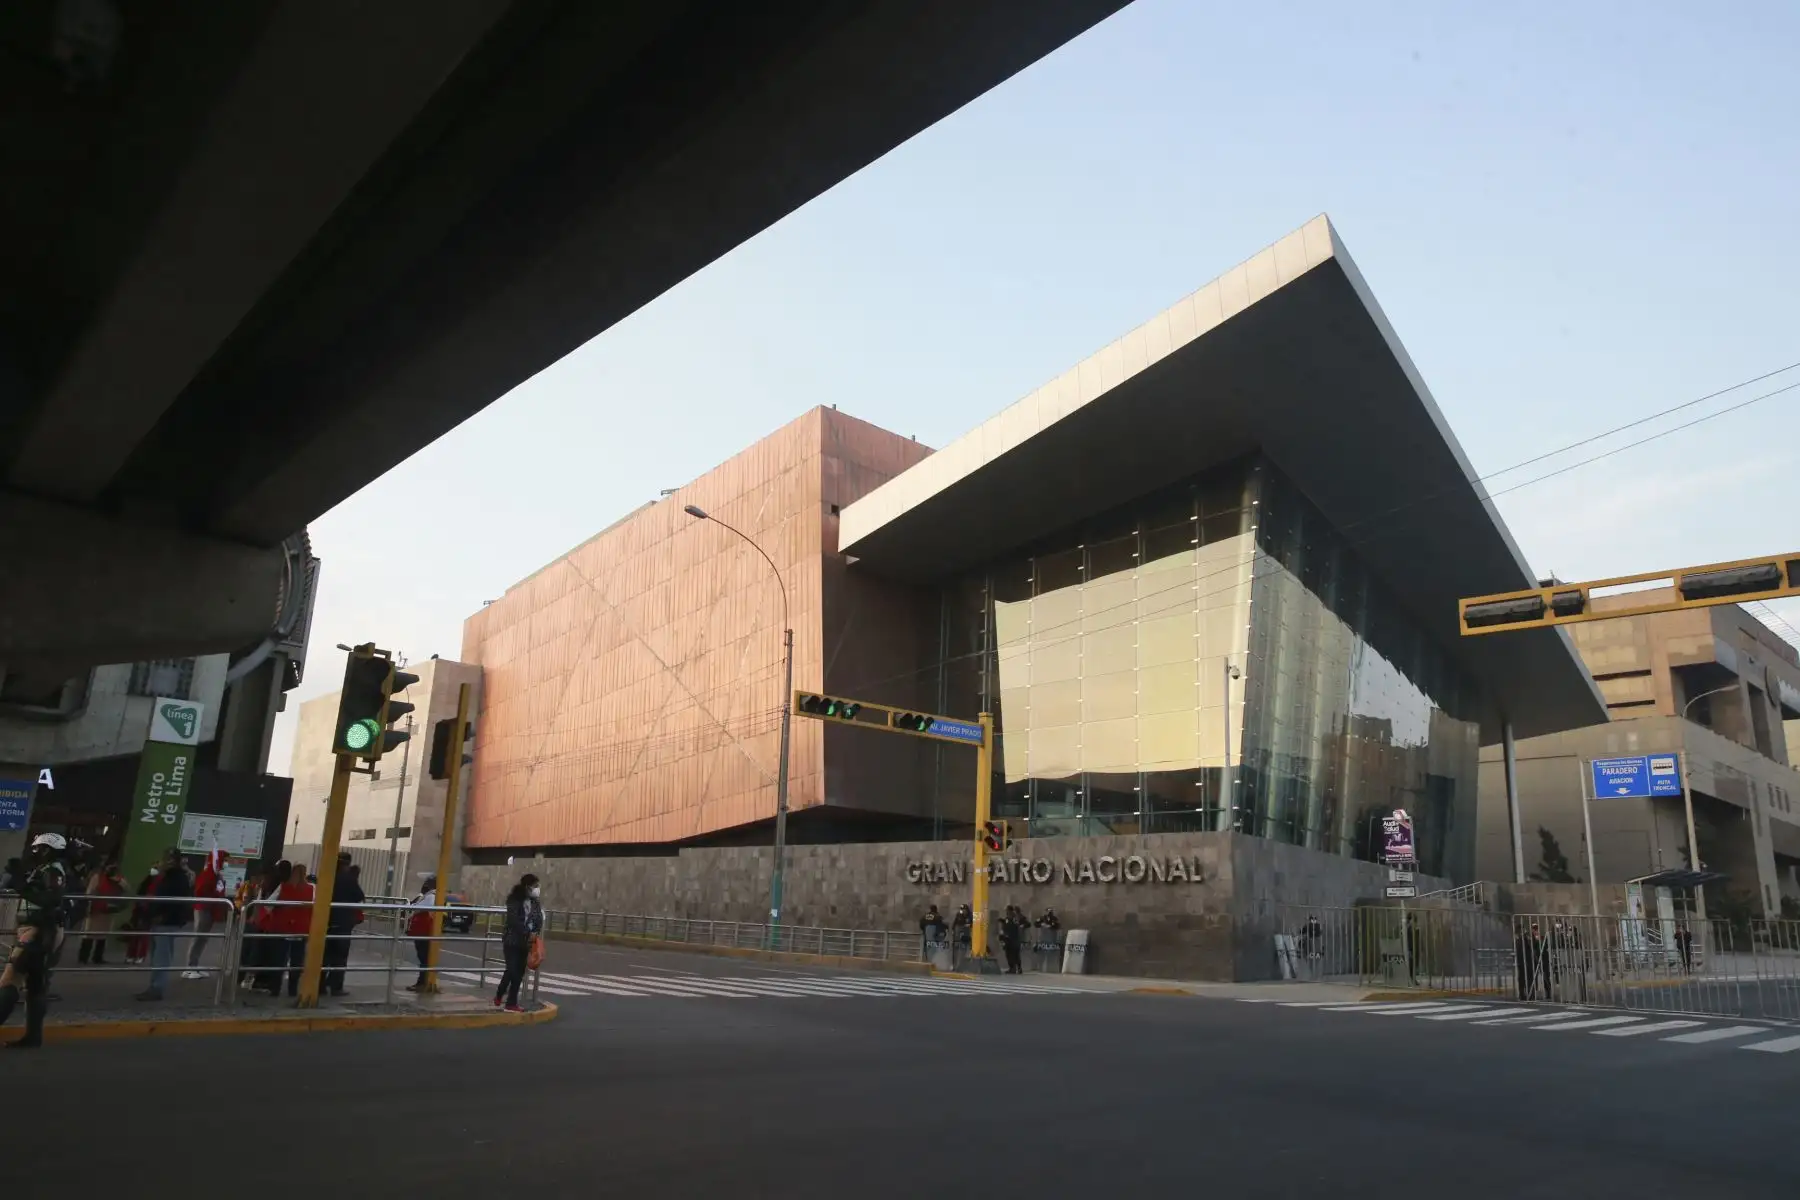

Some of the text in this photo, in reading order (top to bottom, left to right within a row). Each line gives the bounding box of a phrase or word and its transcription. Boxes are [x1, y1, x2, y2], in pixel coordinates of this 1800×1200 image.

[183, 721, 192, 736] 1
[940, 724, 960, 734] JAVIER
[1602, 767, 1638, 775] PARADERO
[140, 772, 165, 823] Metro
[161, 756, 187, 824] de Lima
[906, 860, 966, 883] GRAN
[1063, 854, 1203, 883] NACIONAL
